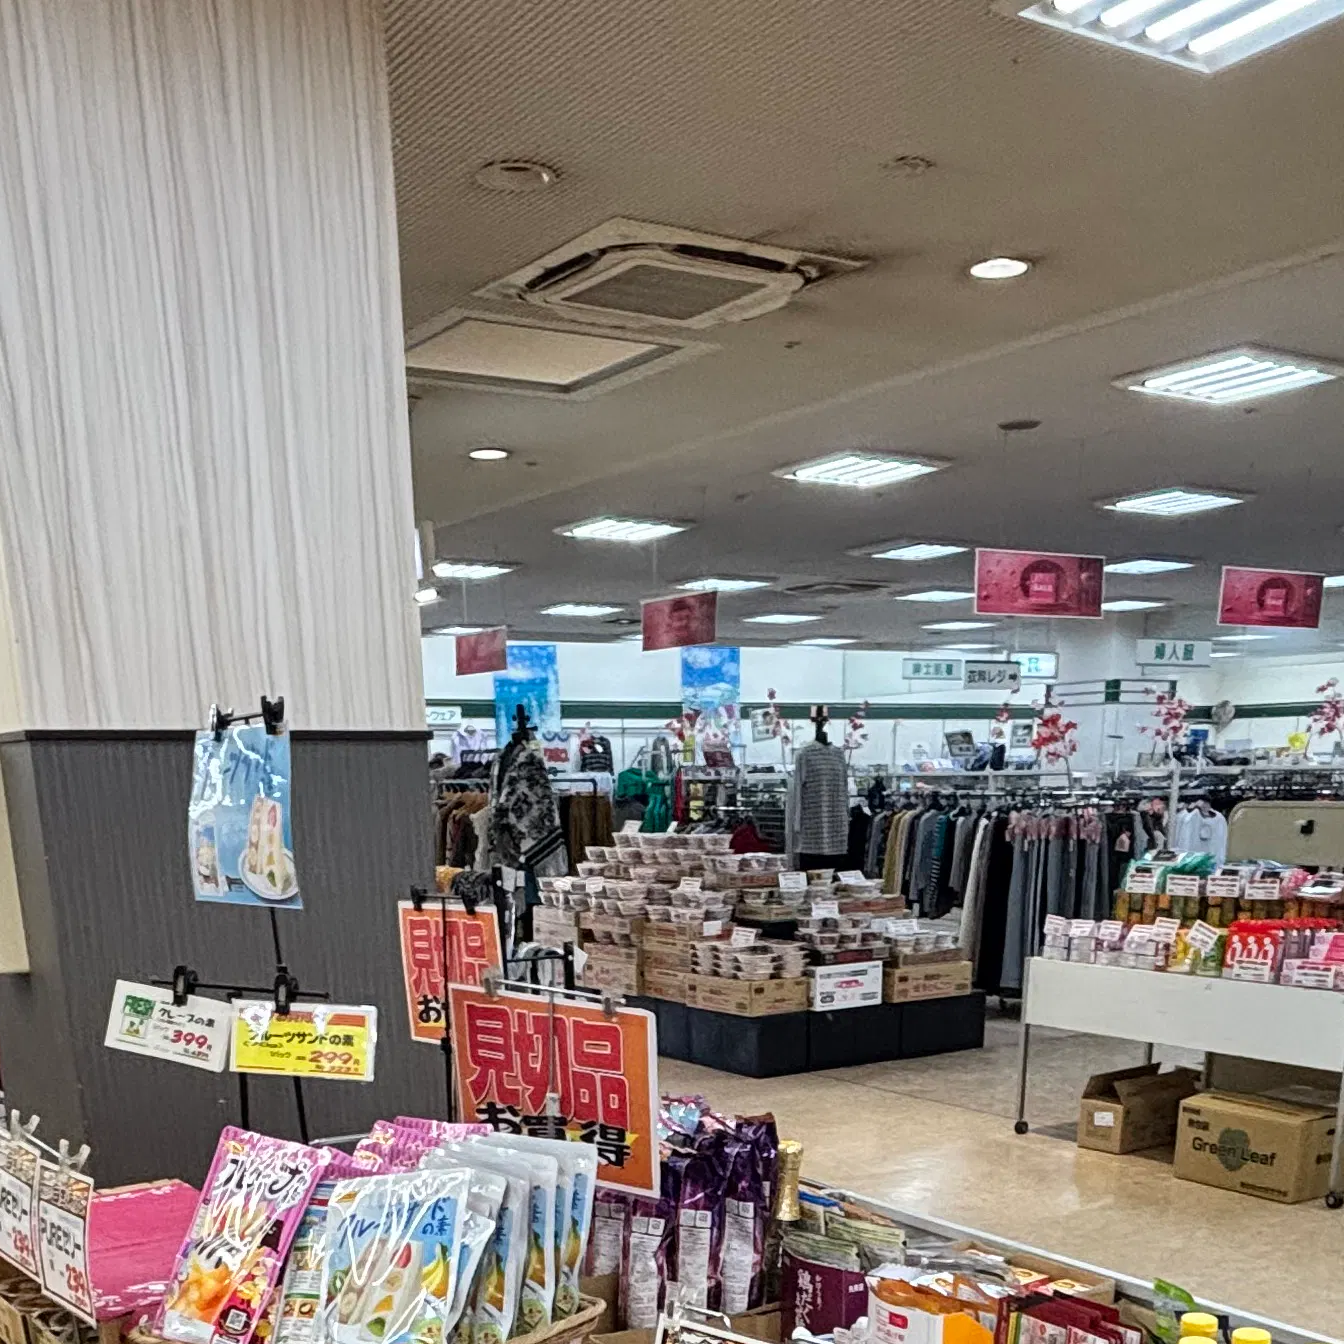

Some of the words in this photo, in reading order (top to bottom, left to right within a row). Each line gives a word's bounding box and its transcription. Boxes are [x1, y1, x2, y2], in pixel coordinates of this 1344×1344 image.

[465, 1004, 631, 1130] 見切品
[1192, 1136, 1236, 1158] Green
[1240, 1147, 1277, 1167] Leaf
